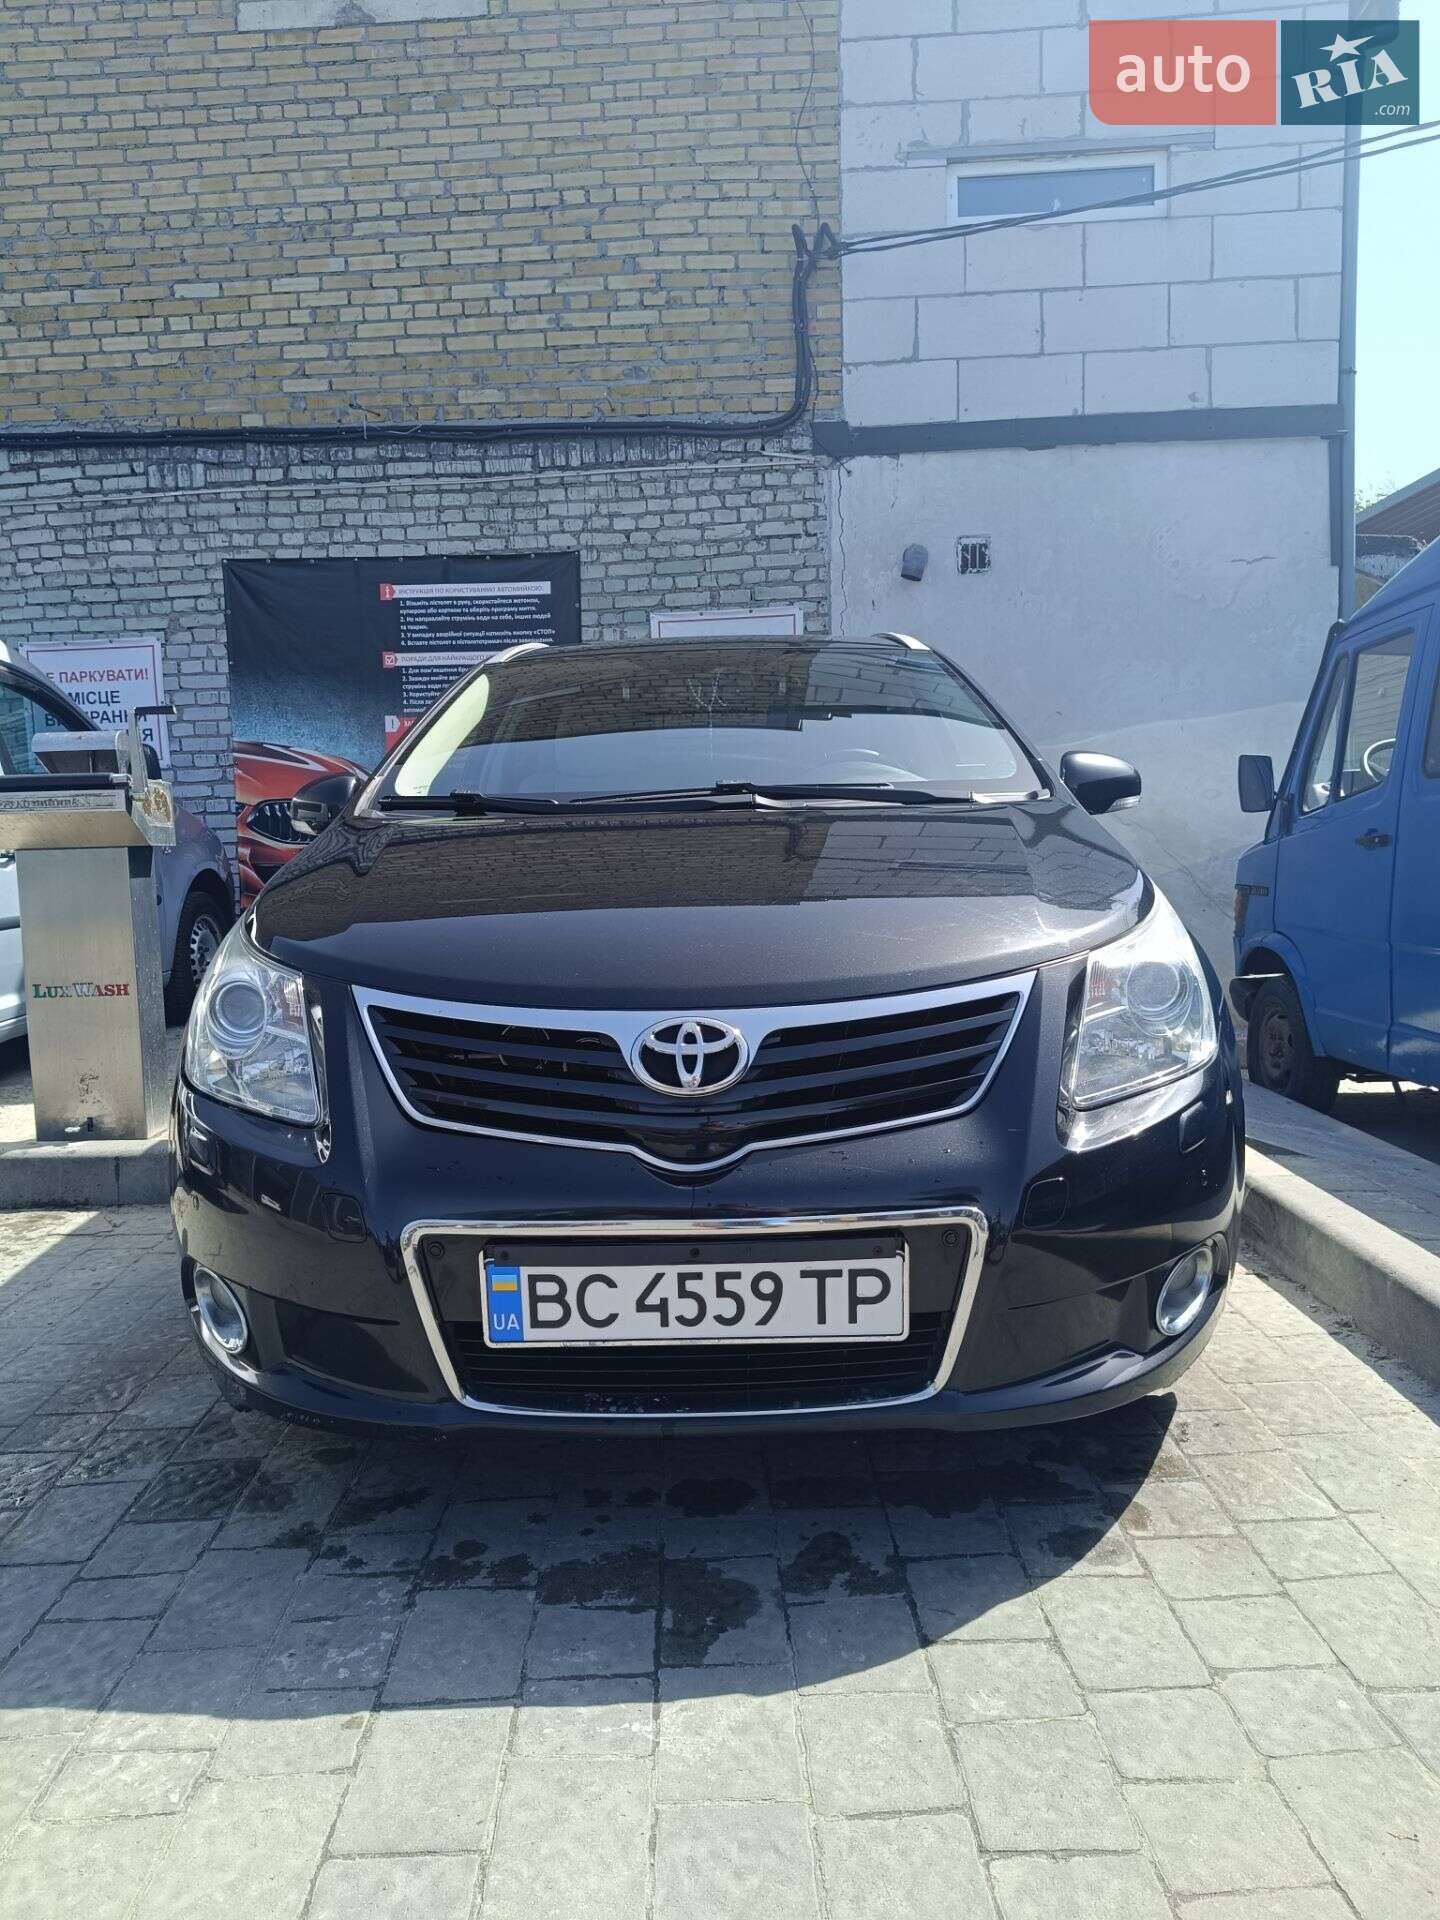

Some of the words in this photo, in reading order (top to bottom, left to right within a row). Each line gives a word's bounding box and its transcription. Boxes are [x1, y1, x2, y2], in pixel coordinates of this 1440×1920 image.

[59, 668, 148, 683] ПАРКУВАТИ!
[68, 690, 121, 706] МІСЦЕ
[528, 1273, 619, 1329] BC
[635, 1270, 784, 1328] 4559
[799, 1268, 891, 1325] TP
[493, 1313, 520, 1331] UA
